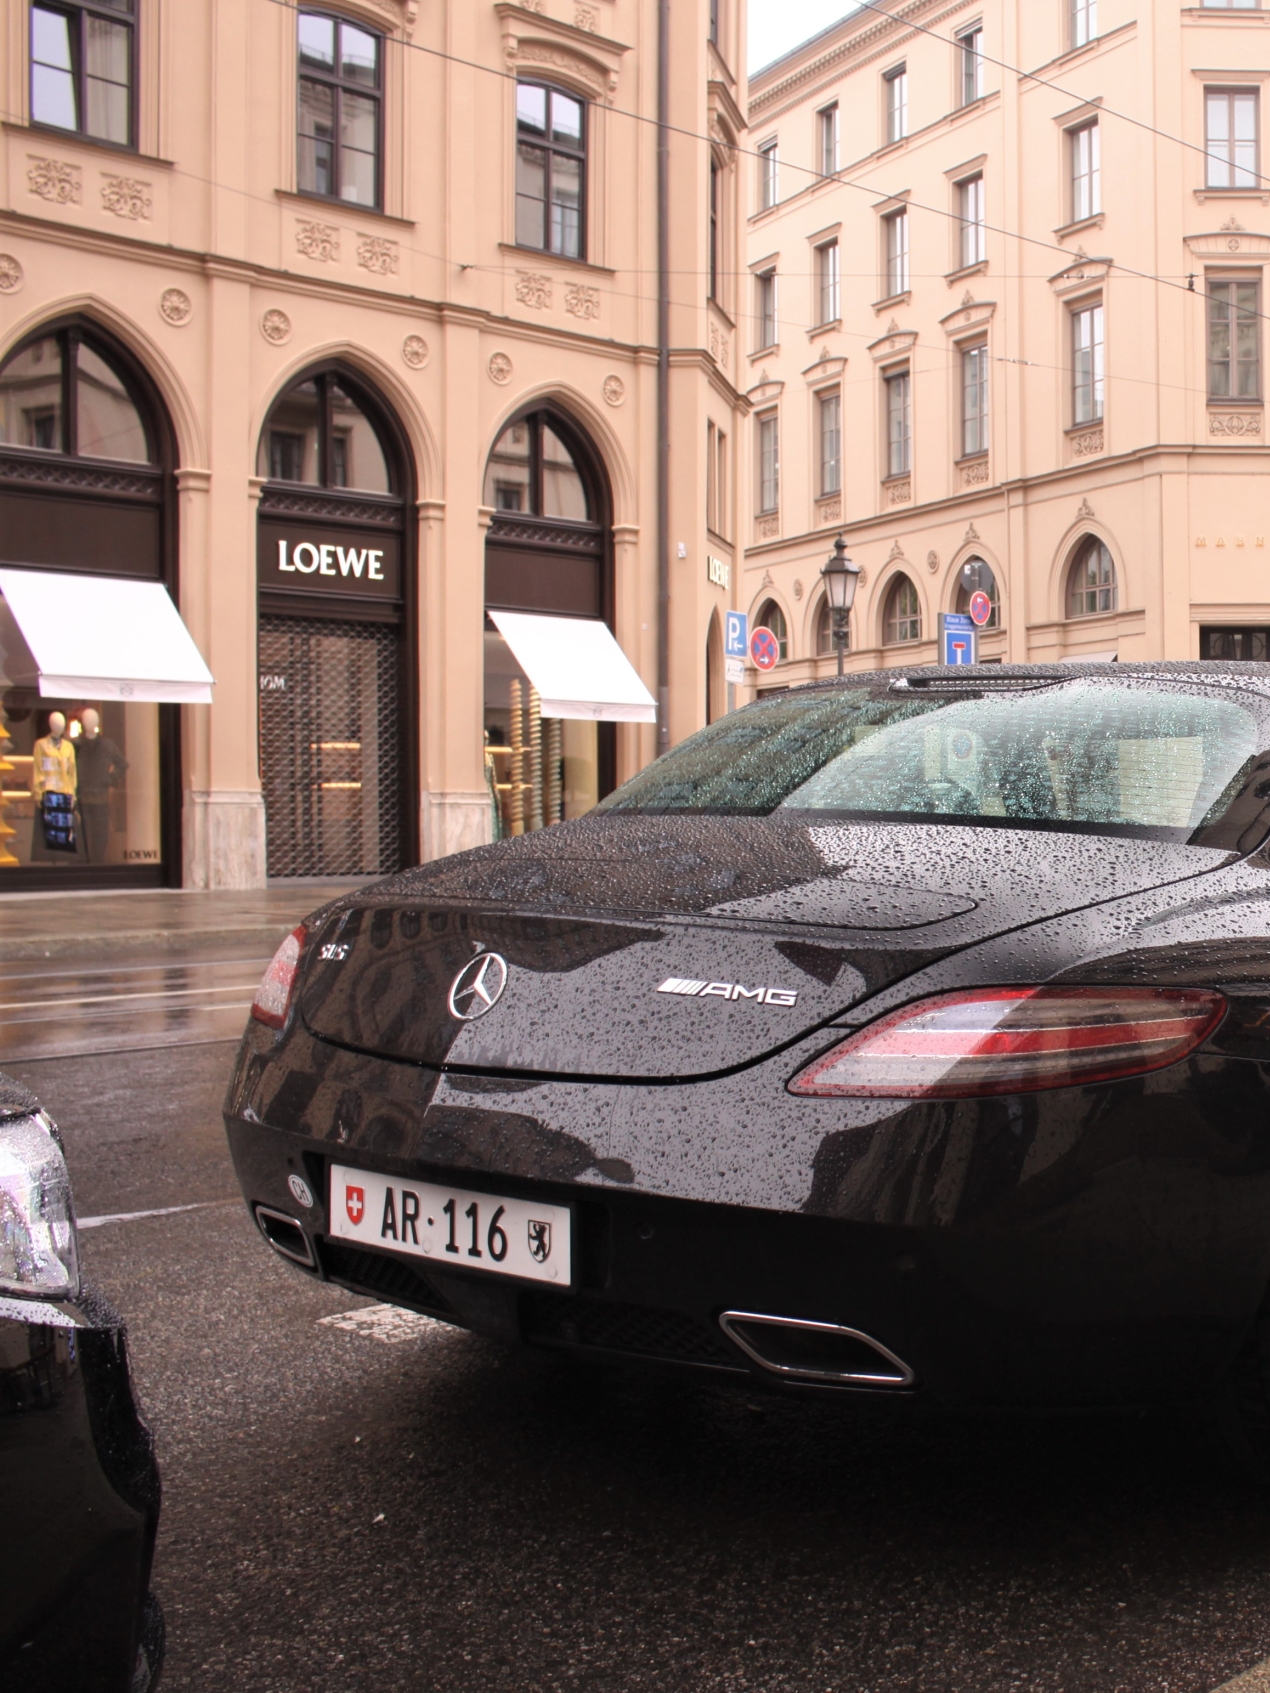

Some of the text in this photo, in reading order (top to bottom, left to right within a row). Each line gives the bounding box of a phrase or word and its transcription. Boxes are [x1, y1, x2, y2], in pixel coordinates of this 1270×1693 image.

[278, 540, 384, 580] LOEWE
[708, 555, 730, 589] LOEWE
[123, 850, 158, 860] LOEWE
[318, 944, 349, 959] SLS
[698, 982, 798, 1006] AMG
[291, 1180, 310, 1202] CH
